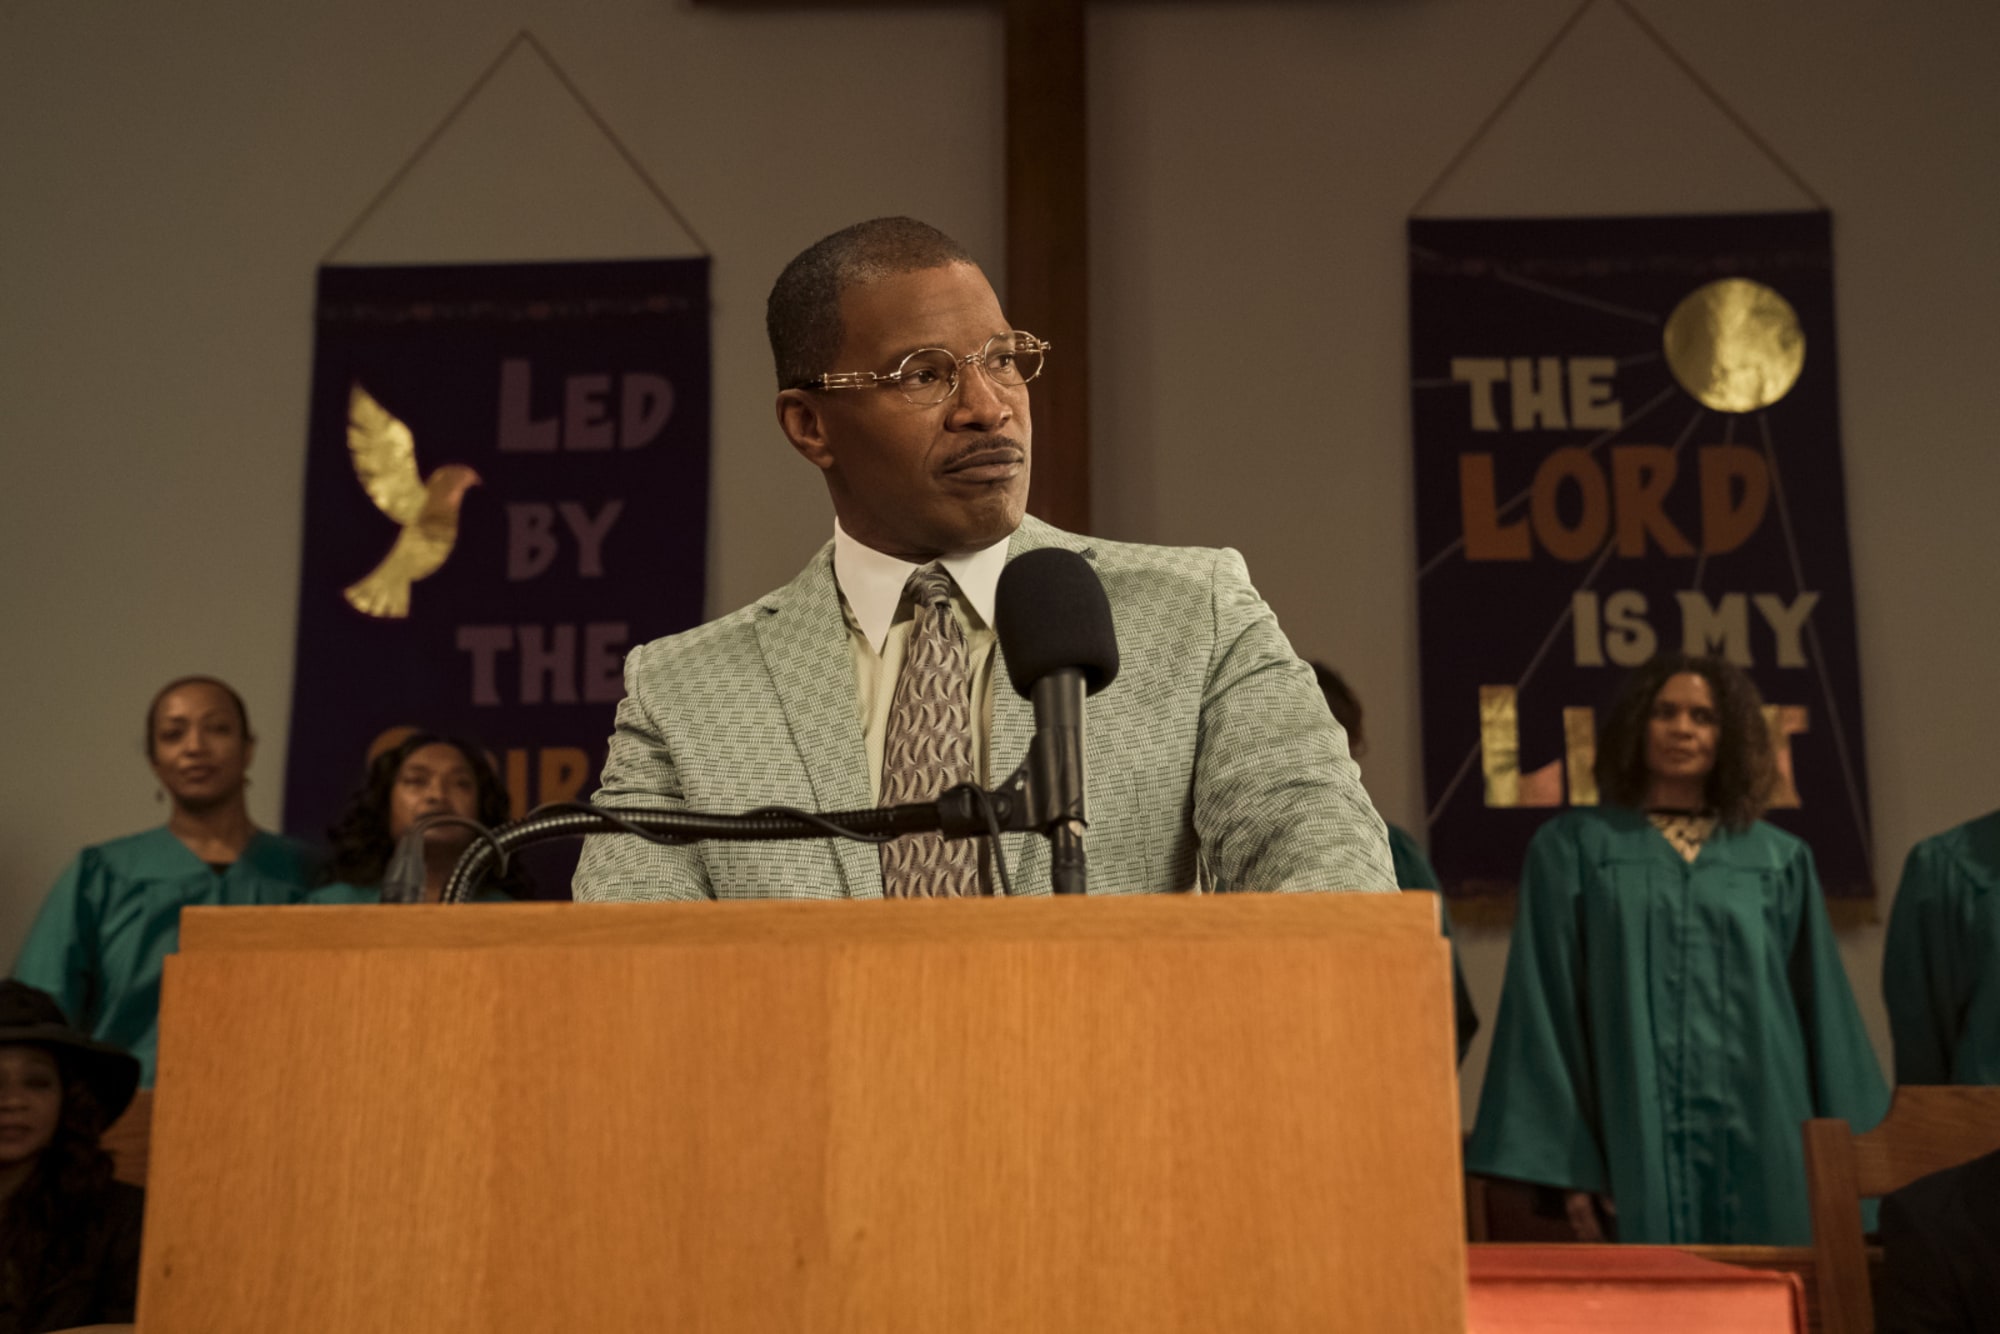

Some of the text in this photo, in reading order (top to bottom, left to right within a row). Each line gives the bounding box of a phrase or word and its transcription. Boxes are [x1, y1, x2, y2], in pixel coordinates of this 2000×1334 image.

[499, 358, 675, 452] LED
[1451, 357, 1623, 431] THE
[506, 500, 625, 581] BY
[1458, 445, 1771, 562] LORD
[456, 622, 629, 705] THE
[1572, 590, 1820, 668] IS MY
[1479, 684, 1809, 808] LIT
